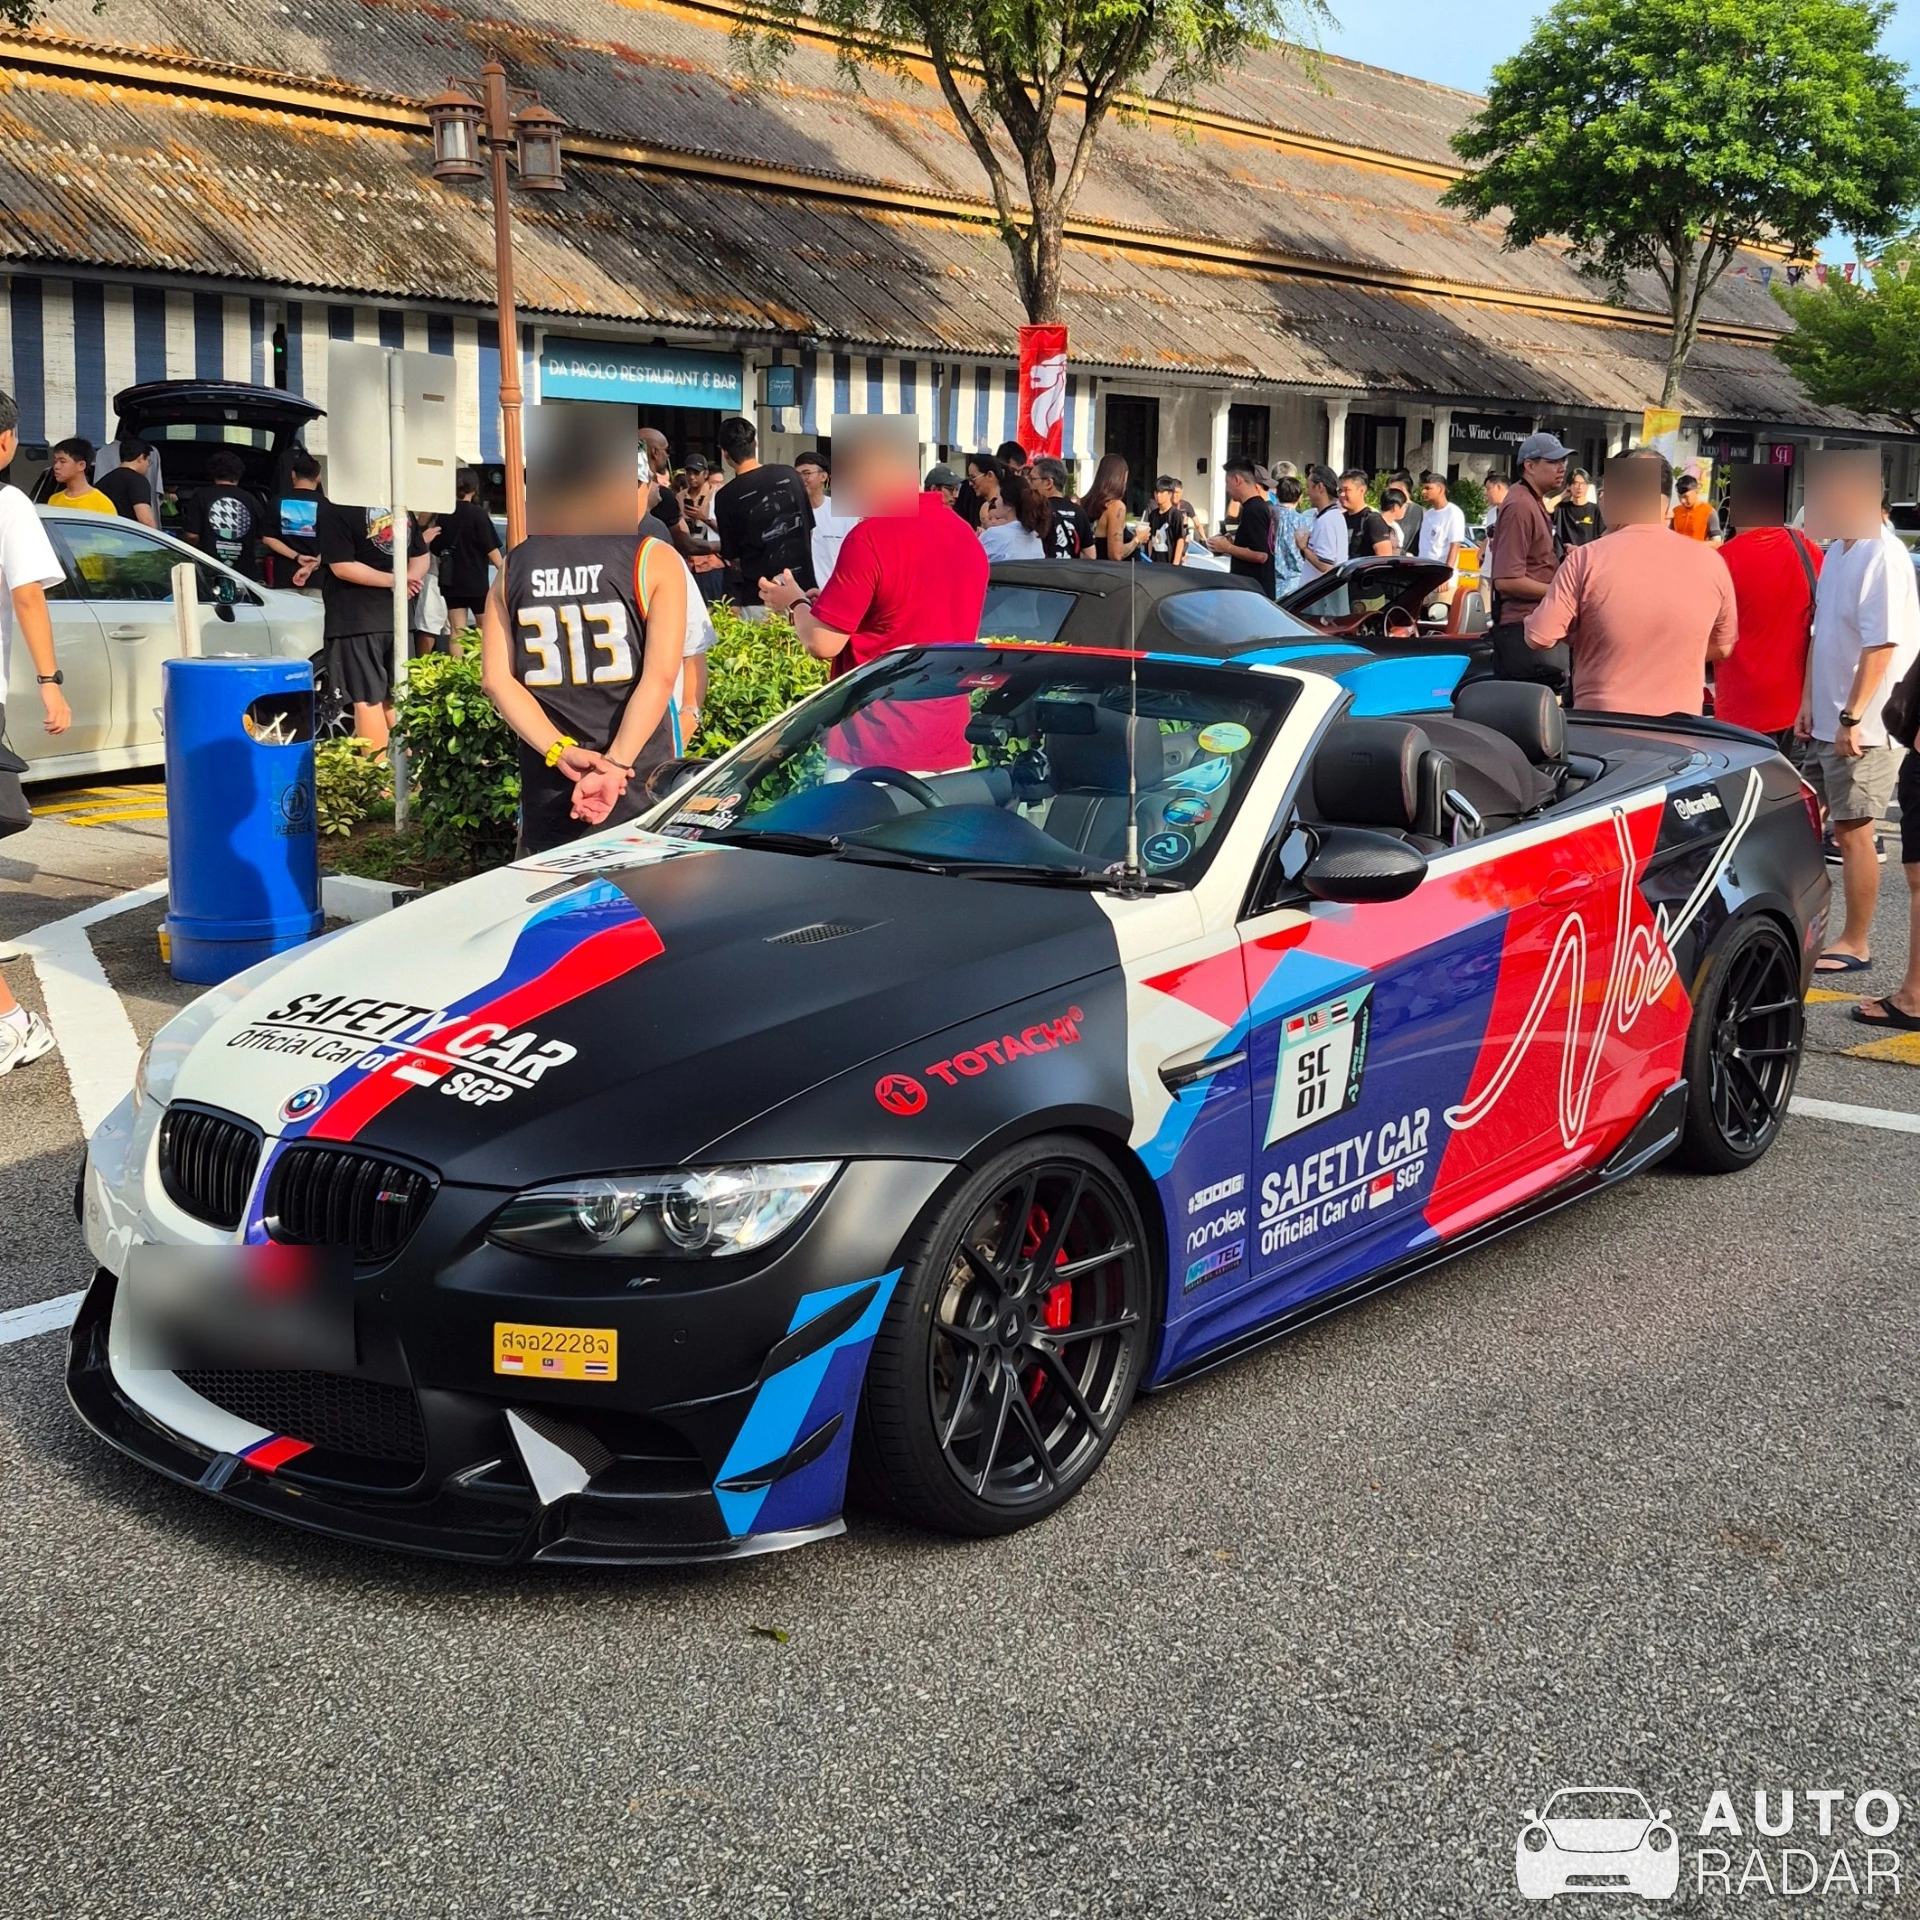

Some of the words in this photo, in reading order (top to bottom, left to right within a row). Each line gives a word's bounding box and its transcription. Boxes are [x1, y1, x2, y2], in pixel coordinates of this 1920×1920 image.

[549, 359, 568, 376] DA
[571, 361, 617, 381] PAOLO
[620, 365, 699, 387] RESTAURANT
[712, 373, 737, 390] BAR
[1451, 423, 1466, 438] The
[1468, 424, 1491, 440] Wine
[531, 564, 603, 597] SHADY
[517, 601, 633, 686] 313
[266, 993, 471, 1043] SAFETY
[445, 1022, 578, 1082] CAR
[226, 1029, 308, 1055] Official
[311, 1039, 365, 1065] Car
[357, 1050, 405, 1073] of
[440, 1071, 514, 1106] SGP
[1297, 1043, 1331, 1085] SC
[1296, 1079, 1327, 1119] 01
[1260, 1130, 1373, 1219] SAFETY
[1377, 1107, 1431, 1166] CAR
[1186, 1207, 1246, 1254] nanolex
[1261, 1207, 1318, 1256] Official
[1322, 1199, 1346, 1227] Car
[1351, 1184, 1368, 1213] of
[1396, 1159, 1425, 1192] SGP
